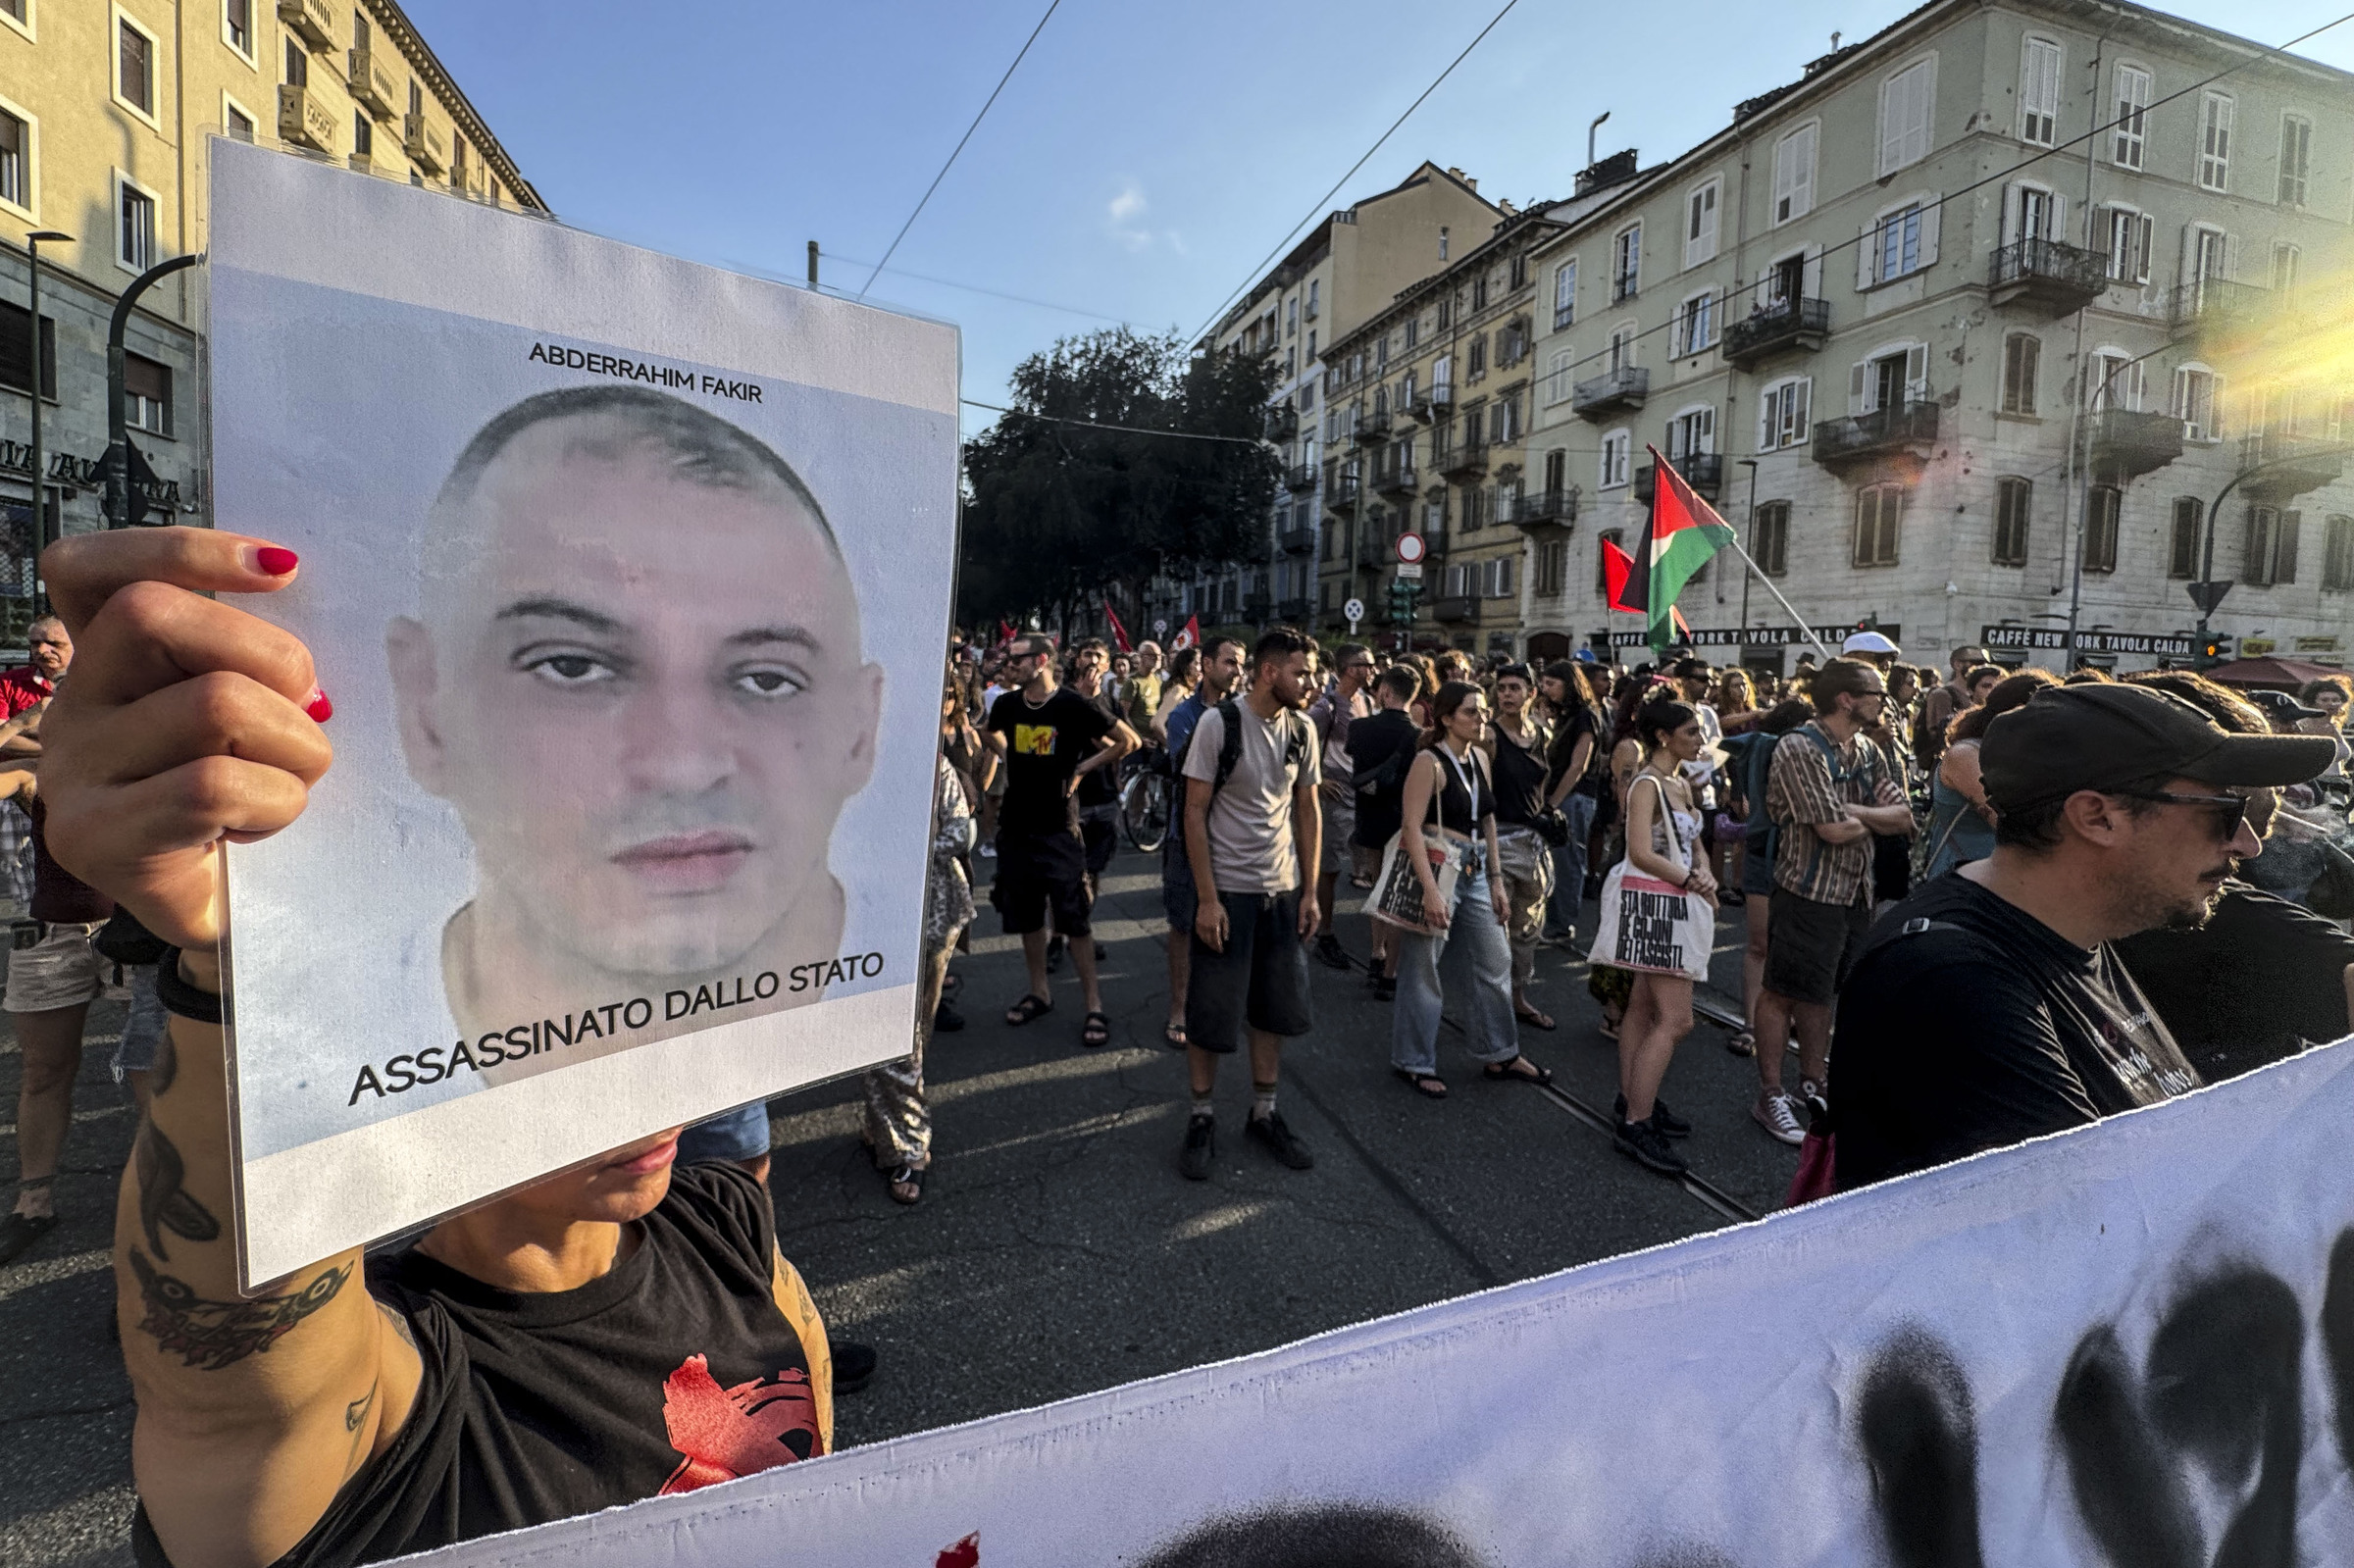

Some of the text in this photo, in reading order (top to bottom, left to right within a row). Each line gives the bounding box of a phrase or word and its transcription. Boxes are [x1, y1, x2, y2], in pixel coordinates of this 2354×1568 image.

[529, 342, 762, 403] ABDERRAHIM FAKIR
[1731, 629, 1790, 644] TVOLA
[2034, 632, 2063, 647] NEW
[2075, 634, 2101, 649] ORK
[2106, 635, 2150, 652] TAVOLA
[2154, 638, 2190, 654] CALDA
[1015, 724, 1058, 756] MTV
[1620, 889, 1639, 915] STA
[348, 951, 884, 1106] ASSASSINATO DALLO STATO
